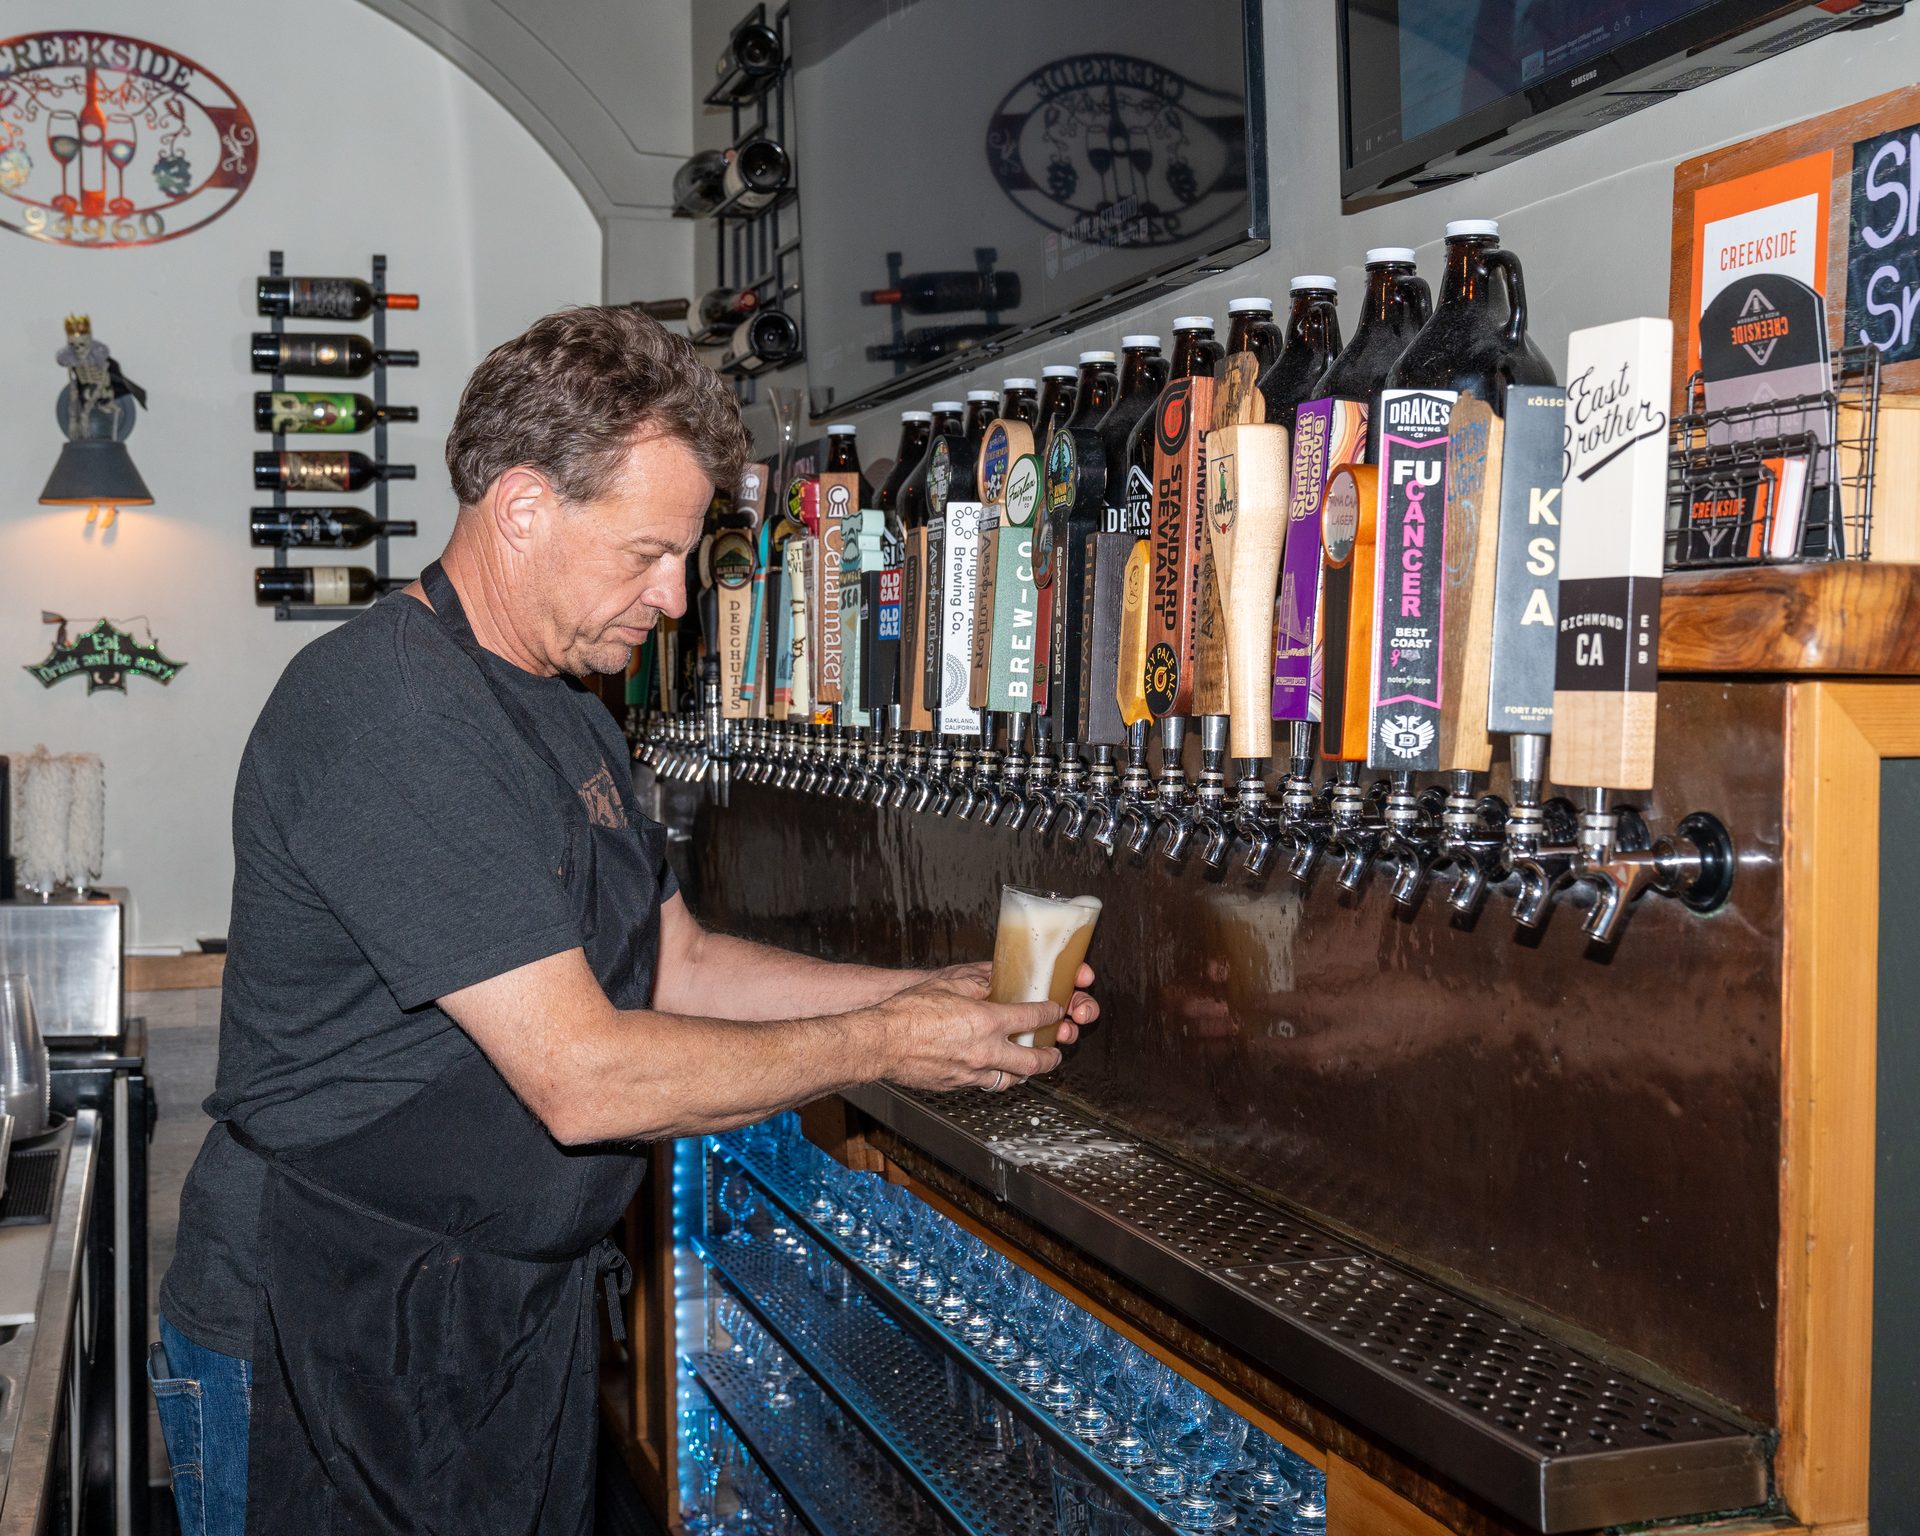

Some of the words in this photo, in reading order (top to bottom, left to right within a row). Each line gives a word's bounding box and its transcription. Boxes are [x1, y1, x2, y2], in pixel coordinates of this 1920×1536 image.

[1570, 69, 1598, 88] SAMSUNG
[24, 205, 165, 244] 94960
[1720, 229, 1797, 271] CREEKSIDE
[1731, 315, 1789, 345] CREEKSIDE
[1528, 396, 1563, 408] KÖLSC
[1567, 361, 1630, 425] East
[1389, 398, 1451, 426] DRAKE'S
[1291, 412, 1315, 521] Sunlight
[1304, 416, 1326, 513] Groove
[1393, 460, 1443, 486] FU
[1154, 478, 1170, 619] DEVIANT
[1164, 463, 1182, 632] STANDARD
[1401, 480, 1426, 618] CANCER
[881, 572, 900, 588] OLD
[950, 546, 966, 606] Brewing
[1055, 546, 1063, 617] RUSSIAN
[841, 588, 858, 610] SEA
[881, 586, 900, 602] CAZ
[880, 608, 899, 622] OLD
[951, 612, 964, 635] Co.
[1560, 613, 1624, 632] RICHMOND
[92, 633, 120, 651] Eat
[880, 622, 899, 637] CAZ
[1078, 543, 1093, 737] FIELDWORK
[1390, 638, 1432, 648] COAST
[1395, 628, 1428, 637] BEST
[730, 600, 742, 710] DESCHUTES
[1054, 623, 1062, 675] RIVER
[1576, 633, 1604, 667] CA
[39, 656, 80, 681] Drink
[1145, 653, 1156, 694] HAZY
[1157, 647, 1175, 669] PALE
[1166, 672, 1176, 701] ALE
[1504, 706, 1530, 714] FORT
[1531, 707, 1553, 716] POIN
[945, 724, 980, 732] CALIFORNIA
